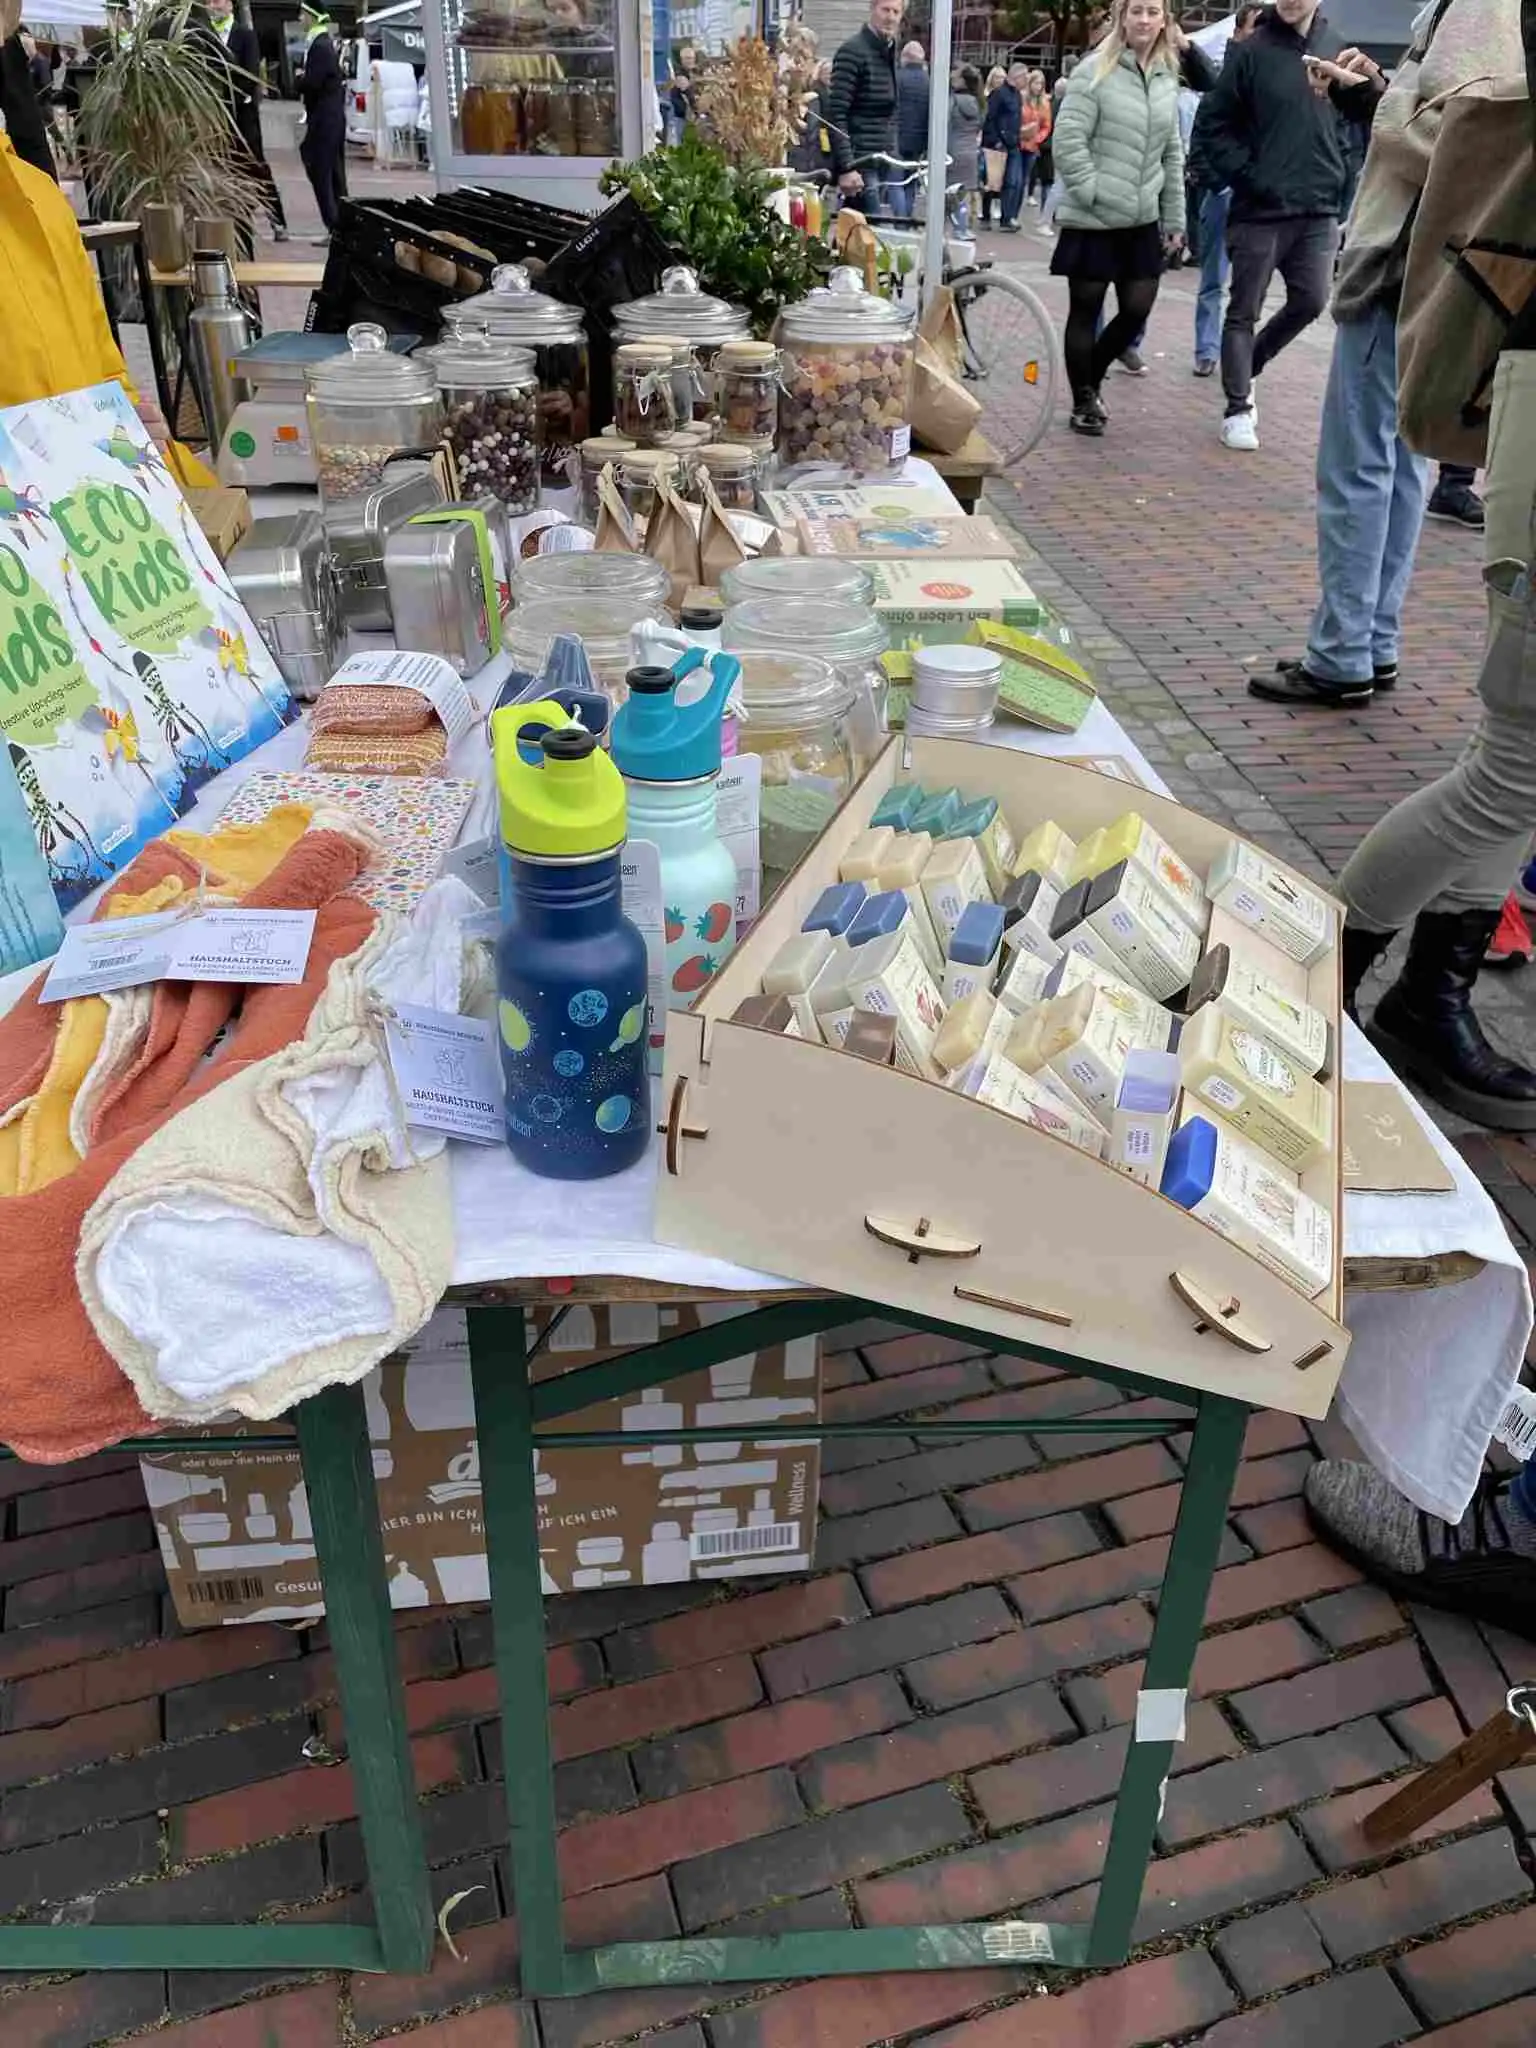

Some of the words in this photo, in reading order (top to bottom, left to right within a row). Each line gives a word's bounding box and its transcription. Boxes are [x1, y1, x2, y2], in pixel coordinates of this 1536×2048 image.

[50, 484, 151, 557] ECO
[190, 954, 291, 965] HAUSHALTSTUCH
[412, 1088, 496, 1113] HAUSHALTSTUCH
[787, 1461, 806, 1515] Wellness
[415, 1511, 443, 1522] BIN
[450, 1508, 477, 1520] ICH
[559, 1513, 586, 1526] ICH
[591, 1506, 618, 1520] EIN
[275, 1581, 322, 1594] Gesu
